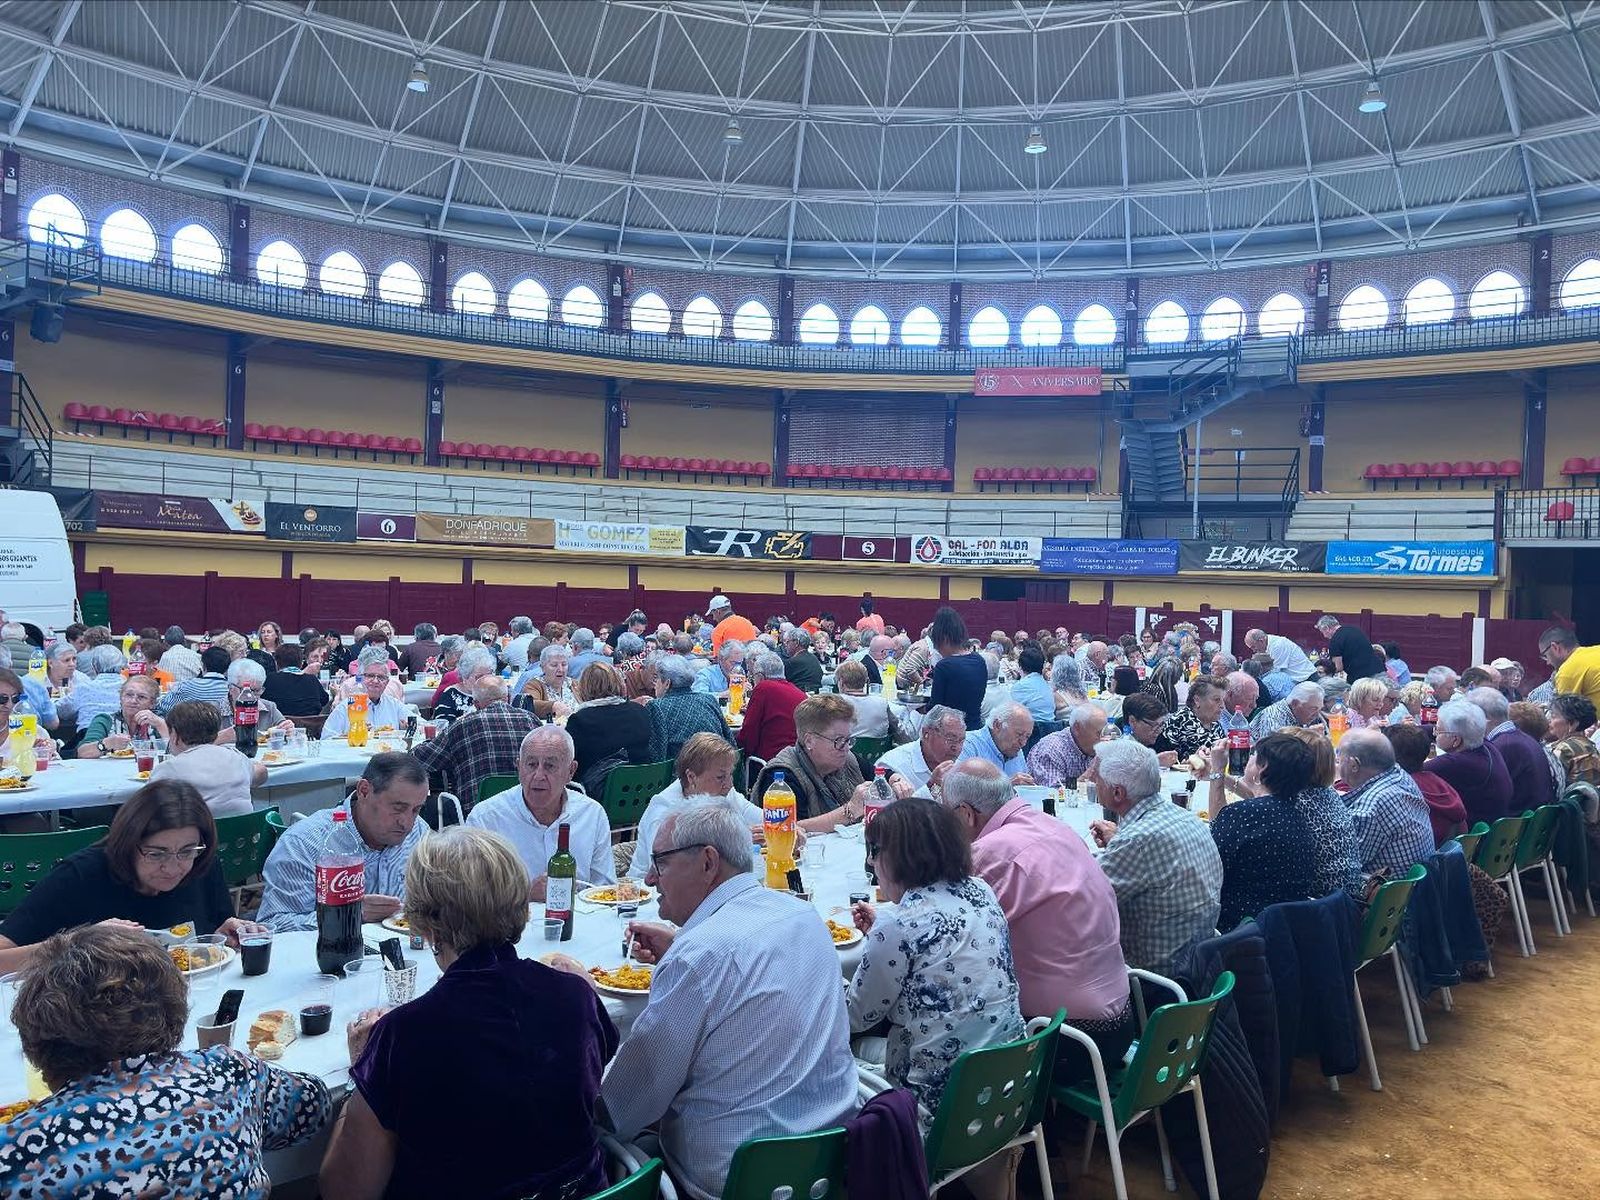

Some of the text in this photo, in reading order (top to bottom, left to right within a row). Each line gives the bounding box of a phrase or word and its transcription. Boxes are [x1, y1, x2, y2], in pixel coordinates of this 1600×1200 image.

[8, 167, 15, 177] 3
[239, 219, 246, 228] 3
[439, 255, 445, 263] 3
[1541, 250, 1549, 259] 2
[1321, 273, 1328, 283] 2
[1129, 289, 1135, 299] 3
[2, 330, 9, 341] 6
[235, 364, 242, 374] 6
[1031, 375, 1099, 387] ANIVERSARIO
[433, 387, 440, 396] 6
[65, 521, 83, 530] 702
[280, 521, 341, 532] EL VENTORRO
[446, 520, 527, 532] DONFADRIQUE
[1000, 540, 1028, 550] ALBA
[1206, 543, 1299, 569] EL BUNKER
[1431, 547, 1484, 555] Autoescuela
[1407, 550, 1484, 572] Tormes
